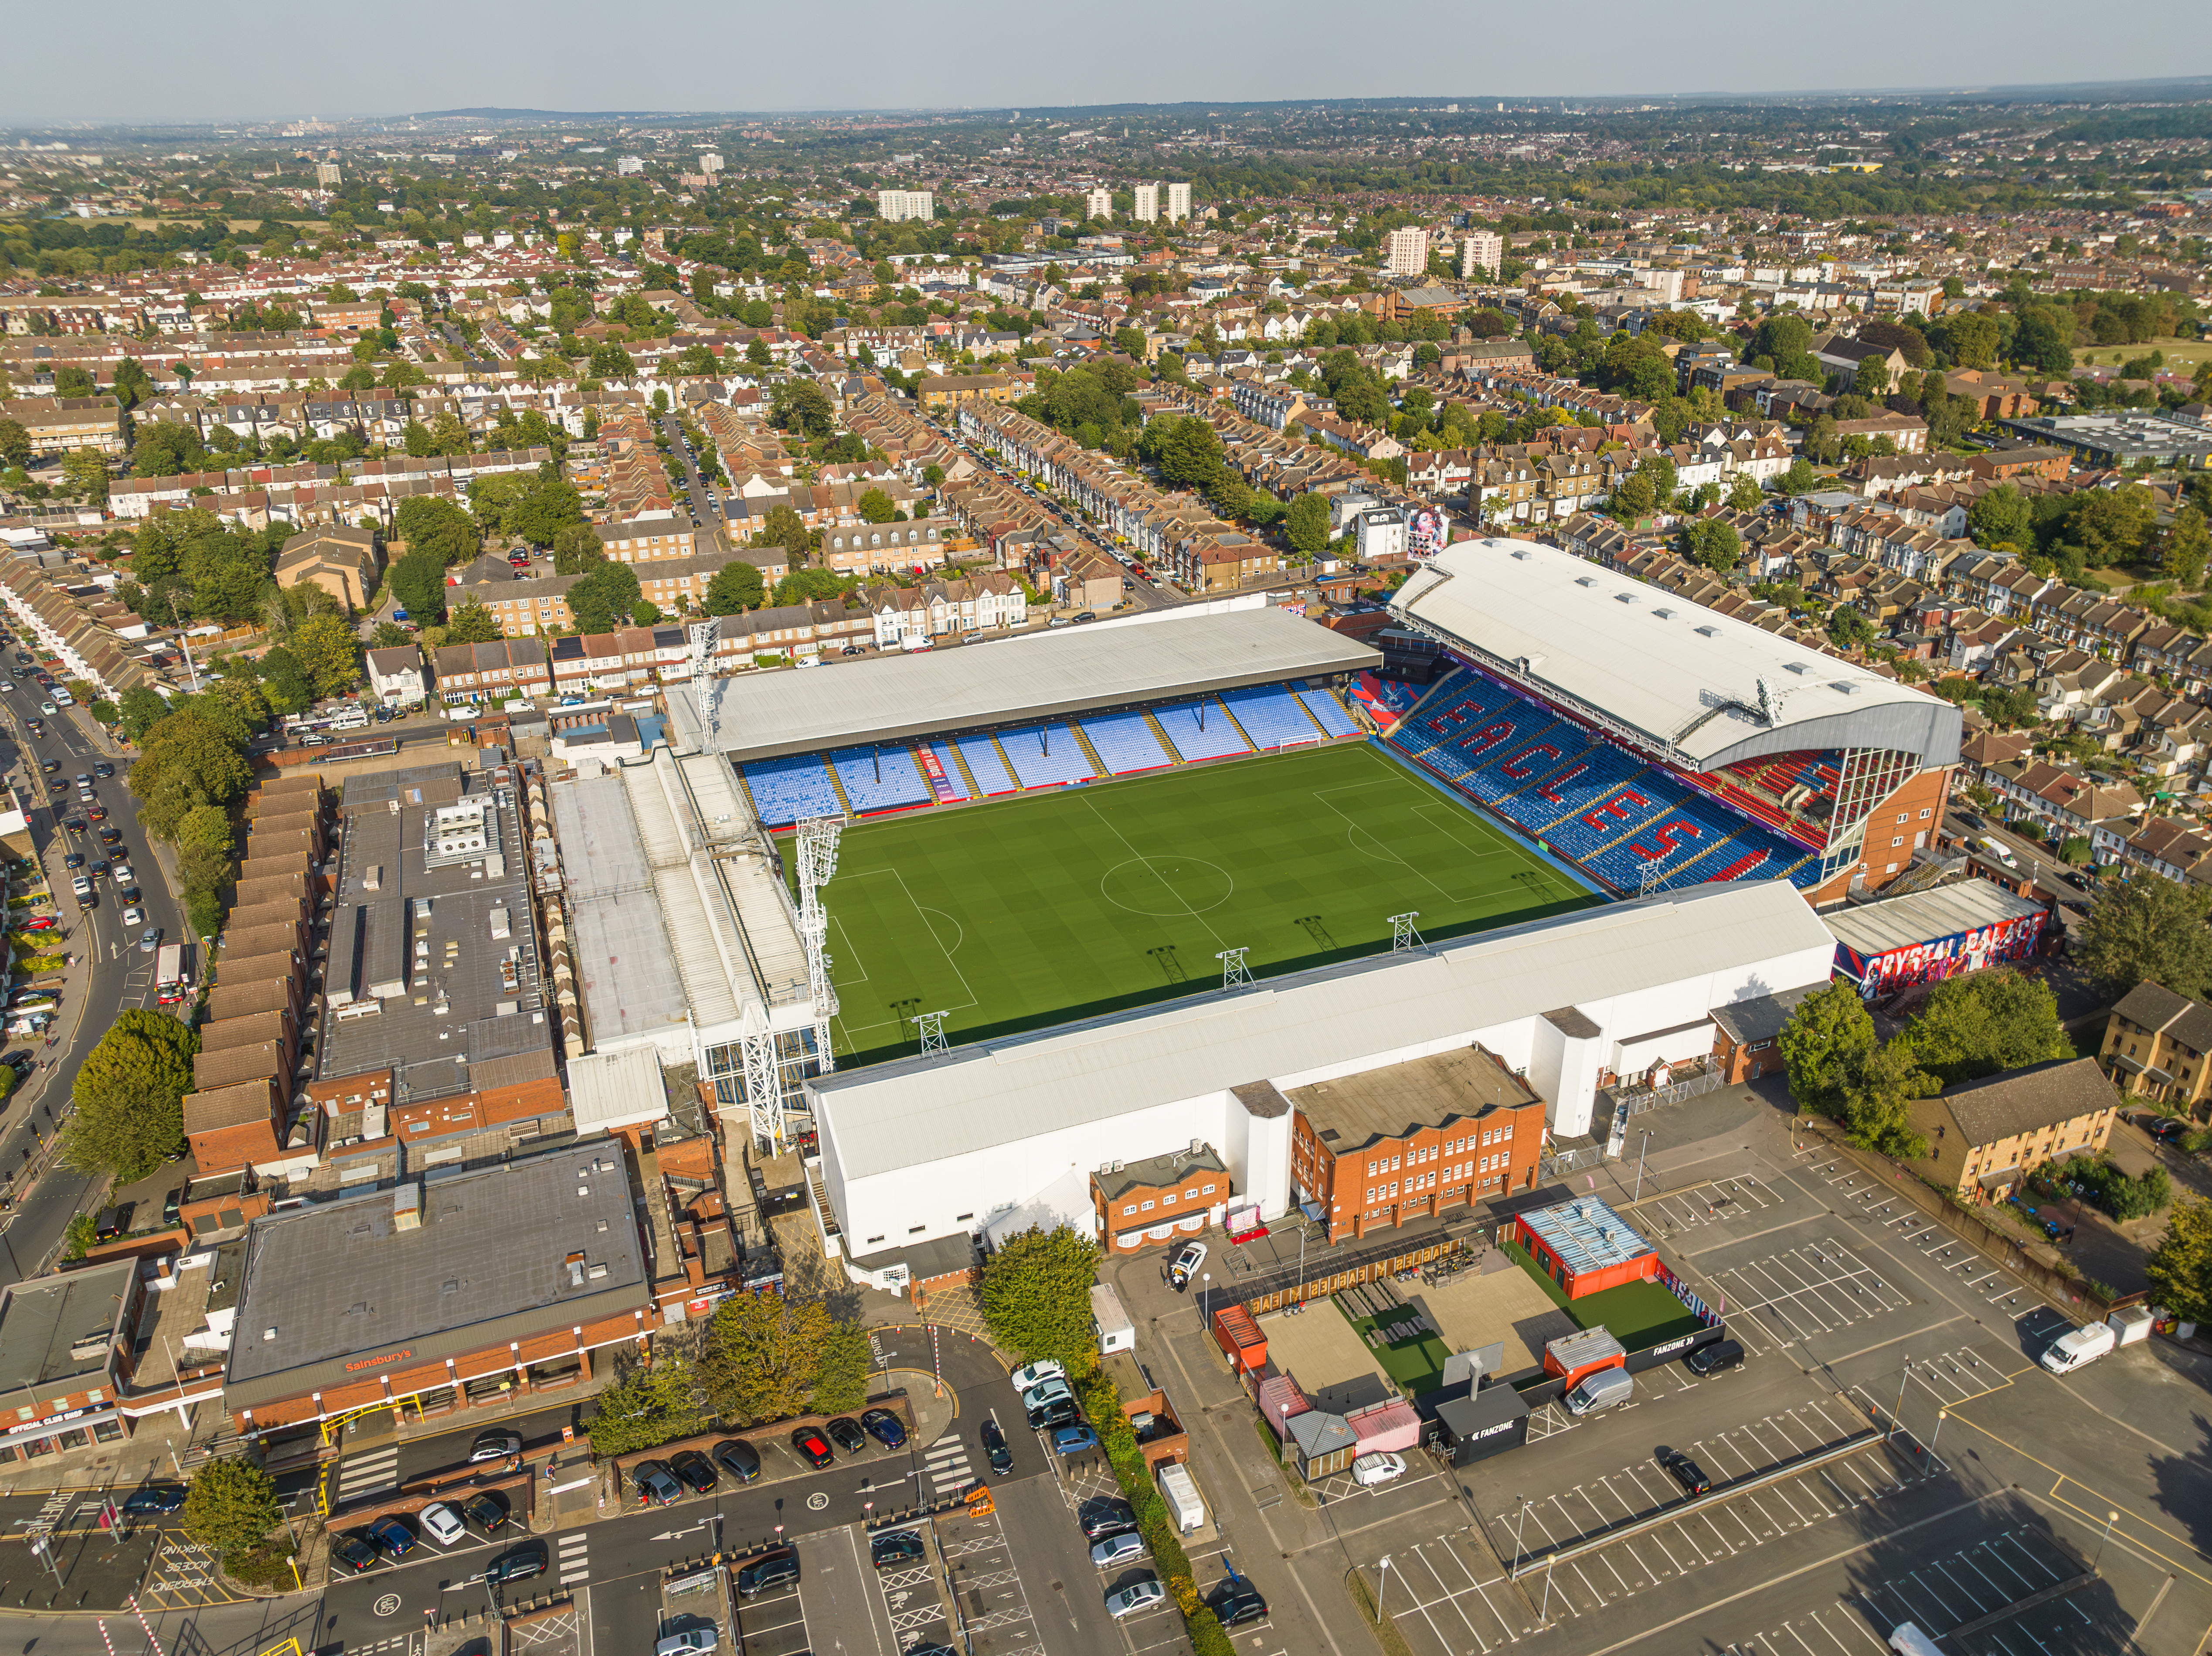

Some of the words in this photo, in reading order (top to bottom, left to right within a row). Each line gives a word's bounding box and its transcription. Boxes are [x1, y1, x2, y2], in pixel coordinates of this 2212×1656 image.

[1278, 604, 1306, 617] E25
[1450, 655, 1458, 664] cinch
[1499, 682, 1508, 690] cinch
[1553, 709, 1590, 734] holmesdale
[1616, 743, 1648, 765] fanatics
[925, 758, 942, 777] SOUTH
[1662, 770, 1675, 780] cinch
[1698, 788, 1710, 799] cinch
[1735, 808, 1748, 819] cinch
[1774, 829, 1787, 840] cinch
[1563, 1263, 1573, 1276] SHOP
[870, 1336, 883, 1355] ENTRY
[1653, 1339, 1685, 1356] FANZONE
[346, 1350, 411, 1372] Sainsbury's
[877, 1357, 887, 1368] NO
[8, 1421, 43, 1435] OFFICIAL
[43, 1415, 64, 1425] CLUB
[64, 1409, 84, 1420] SHOP
[1480, 1420, 1514, 1439] FANZONE
[25, 1491, 76, 1534] TRAFFIC
[70, 1502, 104, 1520] ALL
[161, 1543, 213, 1555] PARKING
[165, 1561, 211, 1572] ACCESS
[145, 1577, 214, 1594] EMERGENCY
